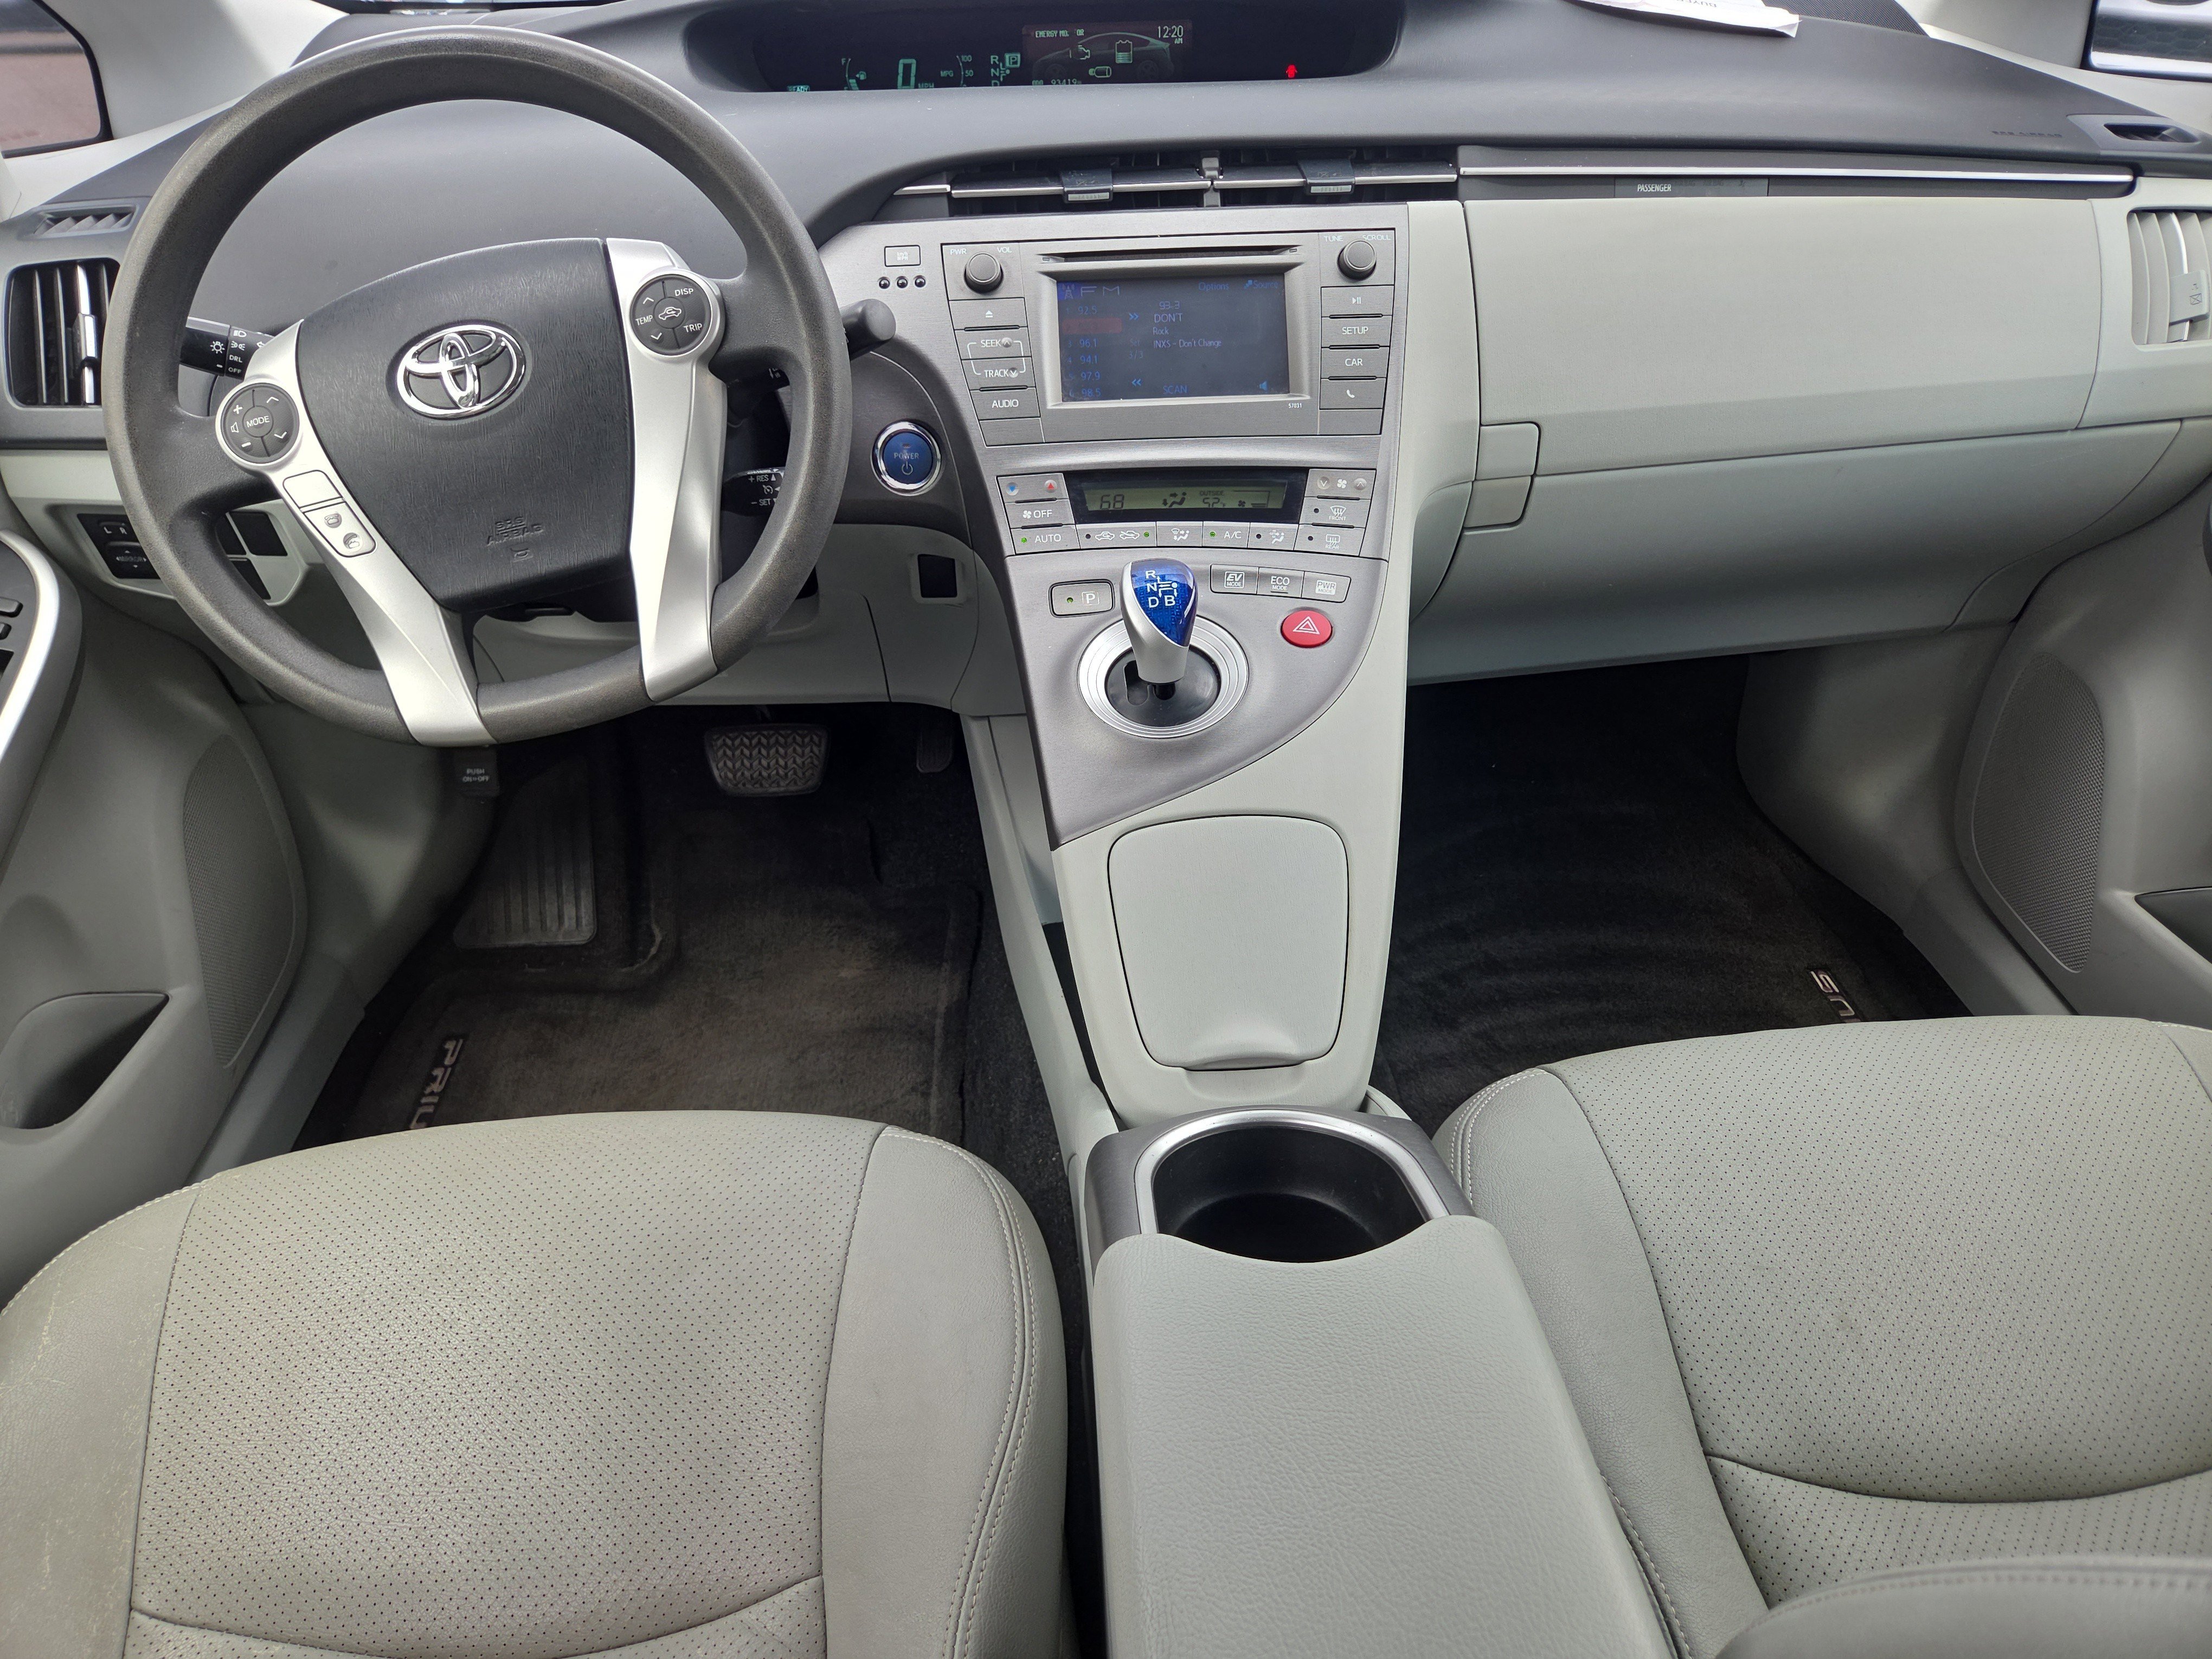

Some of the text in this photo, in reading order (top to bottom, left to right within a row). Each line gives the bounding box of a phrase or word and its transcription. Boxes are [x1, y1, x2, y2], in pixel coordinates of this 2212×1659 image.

[1158, 25, 1184, 38] 12:20
[991, 55, 999, 64] R
[897, 59, 916, 89] 0
[991, 68, 999, 76] N
[1637, 184, 1671, 192] PASSENGER
[1081, 286, 1120, 297] FM
[1198, 282, 1229, 292] Options
[674, 288, 694, 297] DISP
[1078, 305, 1097, 315] 92.5
[1159, 301, 1180, 310] 93.3
[635, 314, 653, 326] TEMP
[1154, 313, 1183, 323] DON'T
[683, 323, 703, 333] TRIP
[1153, 327, 1169, 335] Rock
[1342, 326, 1369, 335] SETUP
[980, 339, 1002, 348] SEEK
[1079, 338, 1098, 348] 96.1
[1153, 340, 1171, 349] INXS
[1179, 339, 1196, 348] Don't
[1198, 339, 1222, 349] Change
[229, 355, 243, 363] DRL
[1080, 355, 1098, 364] 94.1
[1345, 358, 1363, 366] CAR
[984, 369, 1009, 378] TRACK
[1081, 371, 1101, 381] 97.9
[1082, 388, 1102, 397] 98.5
[1163, 384, 1188, 395] SCAN
[992, 400, 1019, 408] AUDIO
[246, 415, 271, 428] MODE
[756, 474, 769, 482] RES
[759, 498, 772, 506] SET
[1100, 494, 1125, 510] 68
[1033, 510, 1053, 518] OFF
[1034, 534, 1062, 543] AUTO
[1224, 531, 1242, 539] A/C
[1145, 570, 1156, 579] R
[1226, 573, 1242, 581] EV
[1271, 576, 1290, 586] ECO
[1317, 581, 1335, 590] PWR
[1147, 582, 1157, 592] N
[1086, 593, 1096, 604] P
[1148, 596, 1159, 608] D
[1165, 595, 1175, 606] B
[409, 1039, 465, 1129] PRIU
